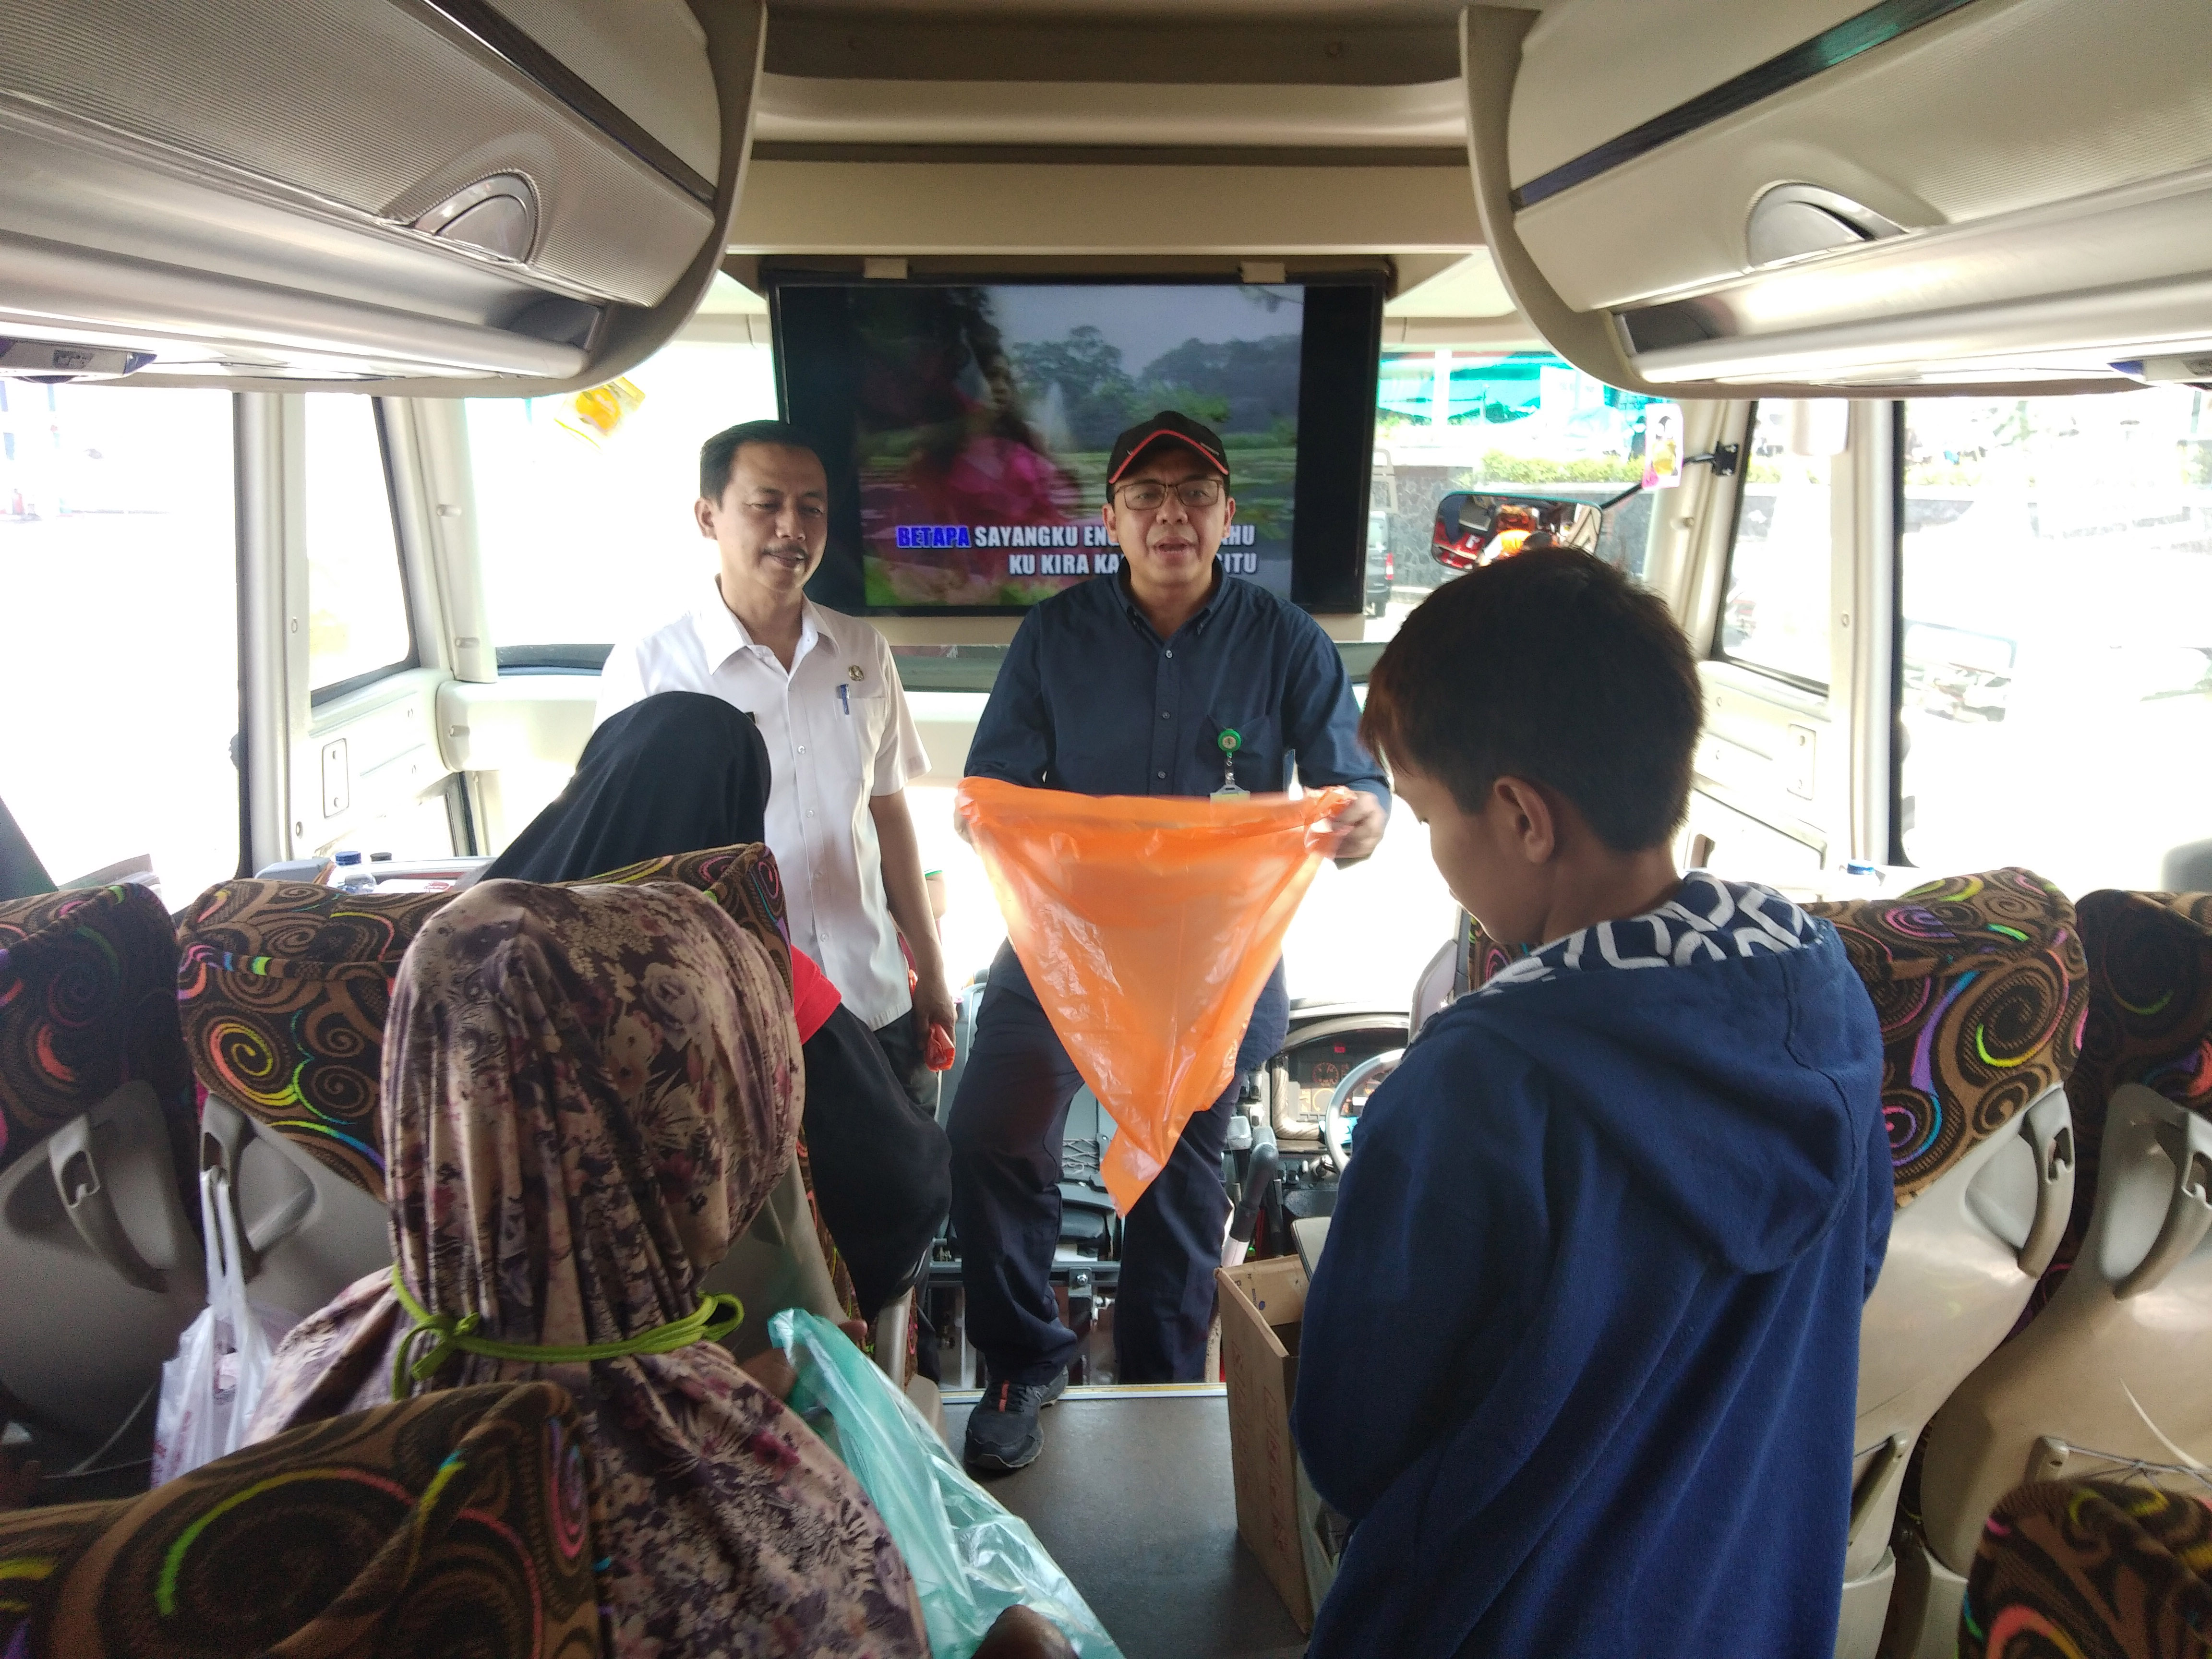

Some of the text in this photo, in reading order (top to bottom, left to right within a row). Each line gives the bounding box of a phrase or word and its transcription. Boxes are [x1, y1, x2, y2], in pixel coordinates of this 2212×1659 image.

[896, 525, 972, 548] BETAPA
[974, 526, 1079, 547] SAYANGKU
[1009, 554, 1036, 575] KU
[1041, 553, 1090, 575] KIRA
[1094, 553, 1126, 574] KA
